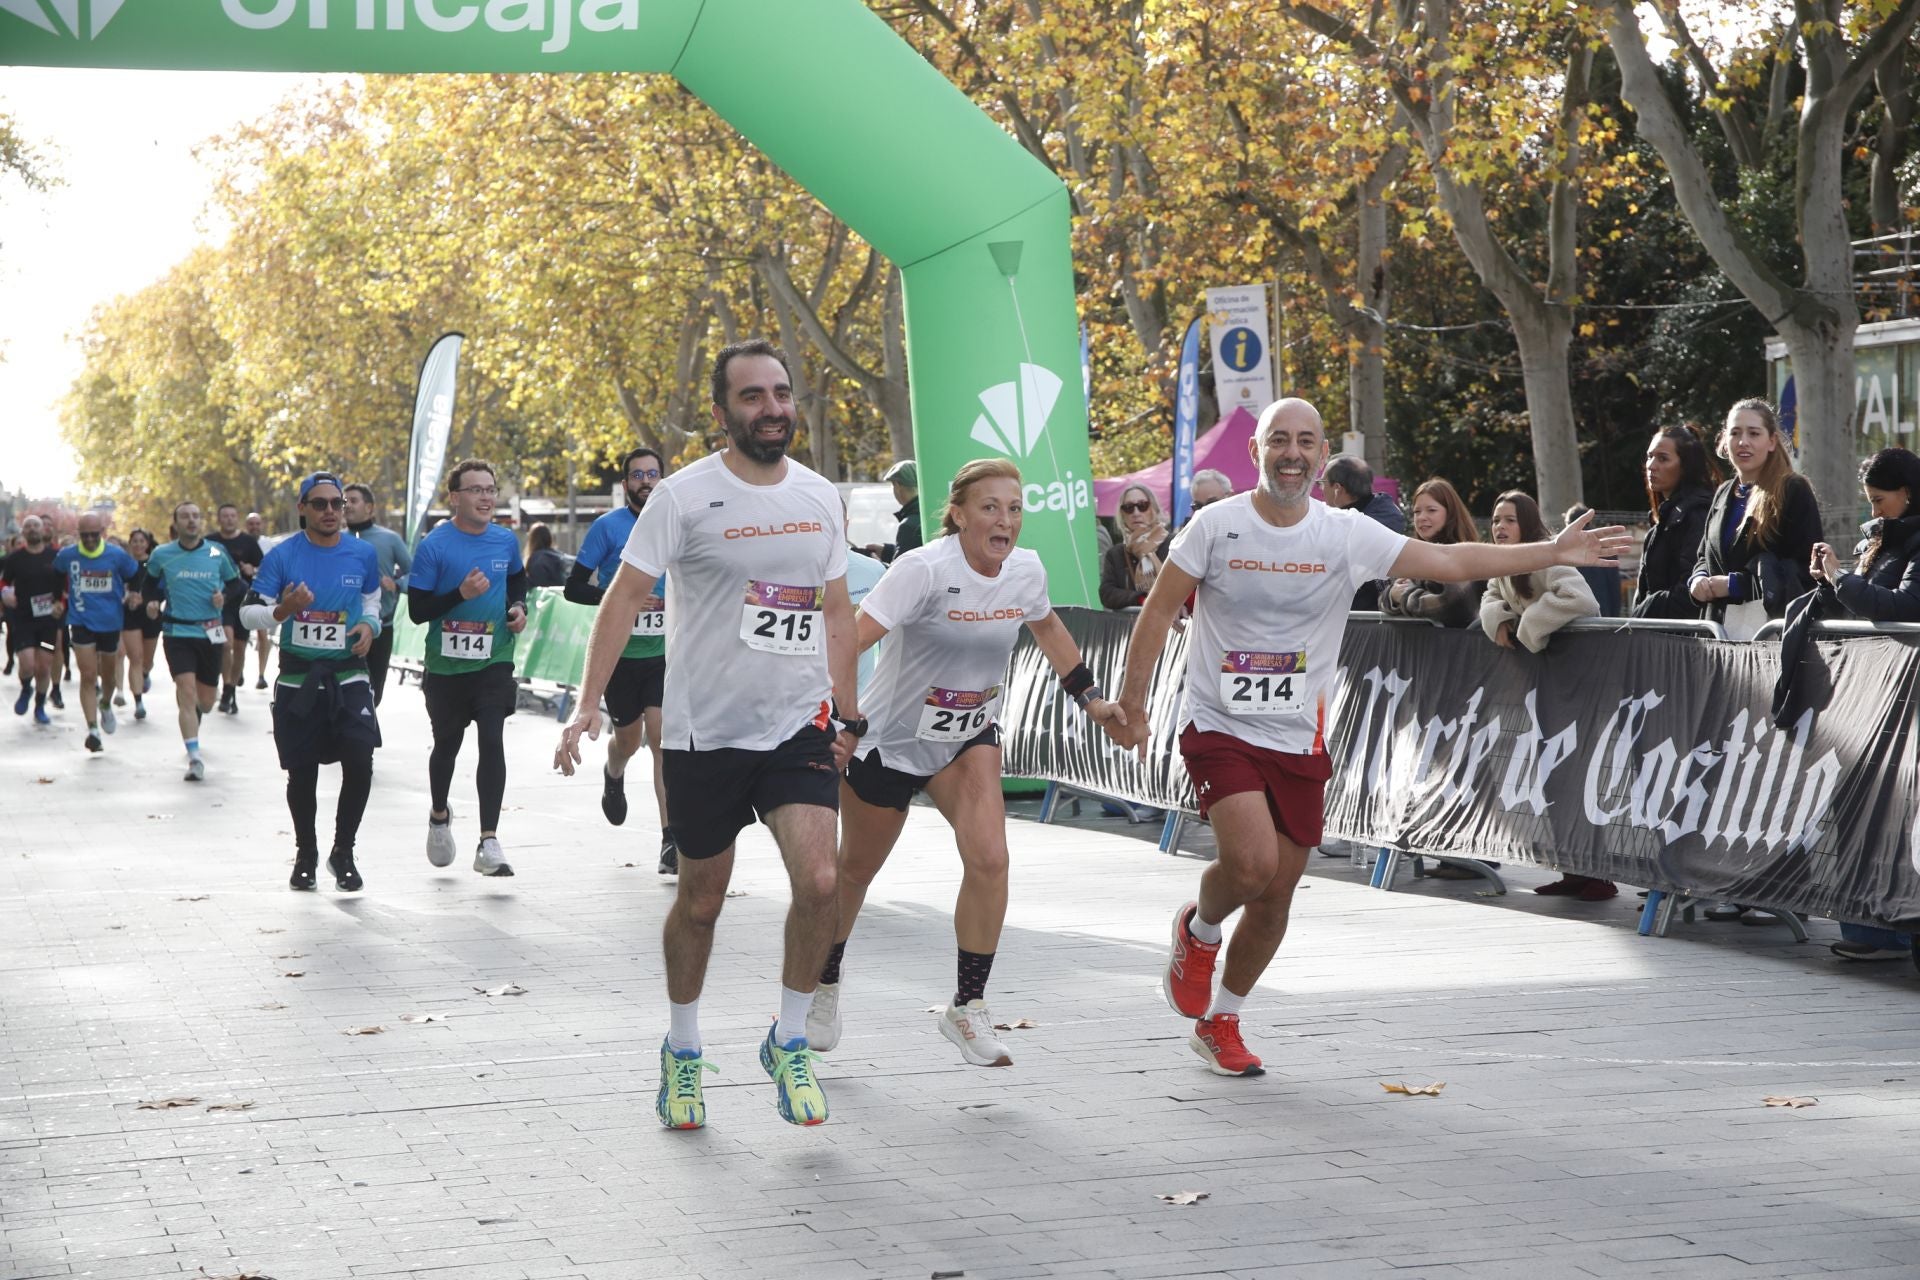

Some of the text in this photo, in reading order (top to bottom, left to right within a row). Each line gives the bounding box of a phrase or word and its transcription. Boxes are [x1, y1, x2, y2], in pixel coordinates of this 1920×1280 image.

[1855, 373, 1920, 434] AL
[1021, 471, 1089, 520] caja
[724, 522, 822, 539] COLLOSA
[177, 570, 212, 579] ADIENT
[1228, 559, 1326, 574] COLLOSA
[85, 578, 107, 589] 589
[634, 613, 664, 628] 113
[947, 608, 1024, 622] COLLOSA
[300, 624, 337, 641] 112
[753, 610, 813, 642] 215
[449, 634, 485, 652] 114
[1231, 676, 1294, 702] 214
[931, 706, 987, 732] 216
[1348, 664, 1500, 809] Norte
[1500, 688, 1577, 817] de
[1584, 688, 1843, 856] Castilla
